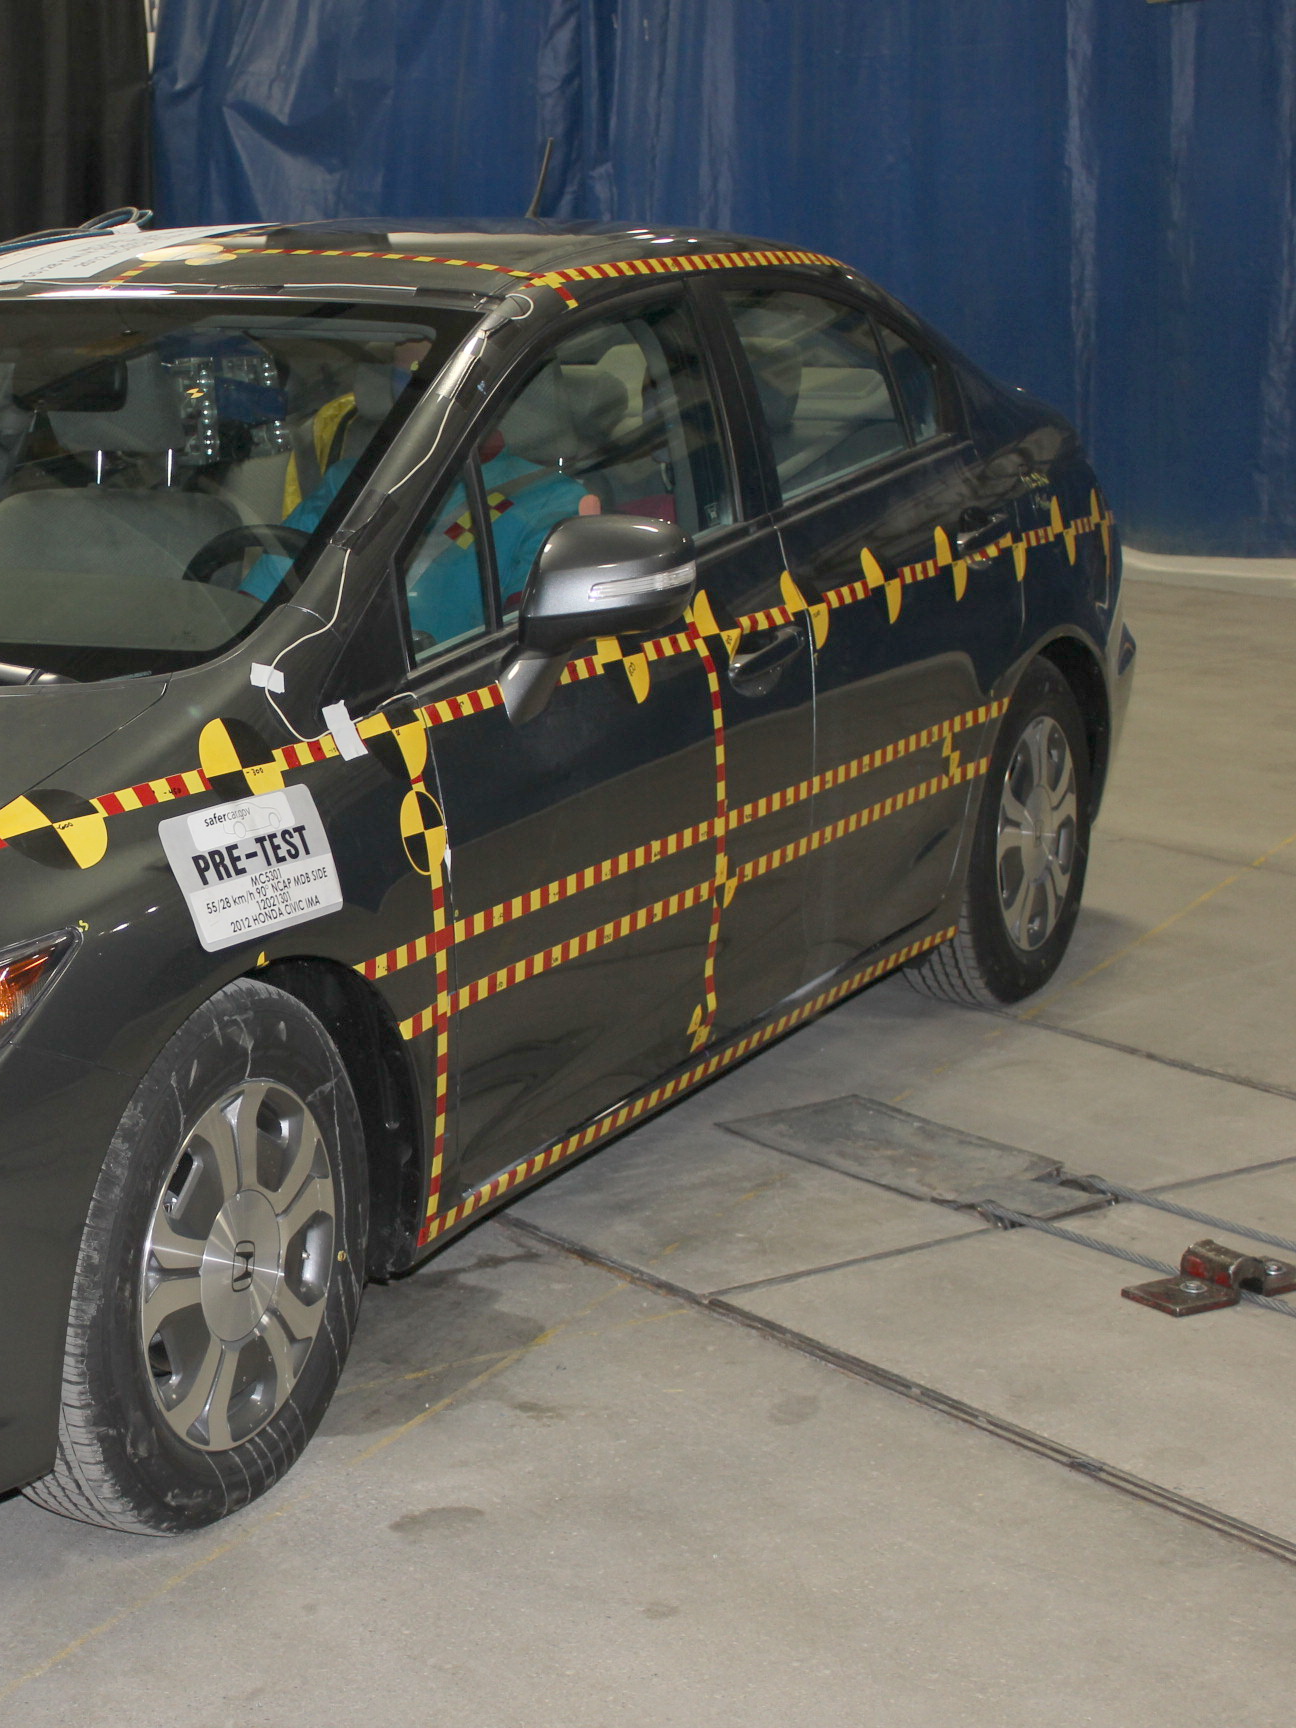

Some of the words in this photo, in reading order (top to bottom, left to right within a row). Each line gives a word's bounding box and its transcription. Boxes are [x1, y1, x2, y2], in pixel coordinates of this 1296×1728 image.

[191, 825, 311, 886] PRE-TEST
[206, 897, 232, 914] 55/28
[233, 890, 256, 906] km/h
[271, 880, 292, 893] NCAP
[294, 872, 311, 886] MDB
[312, 867, 328, 880] SIDE
[250, 868, 282, 887] MC5301
[230, 917, 252, 933] 2012
[252, 908, 284, 926] HONDA
[284, 900, 305, 915] CIVIC
[305, 895, 321, 909] IMA
[256, 891, 292, 911] 12021301
